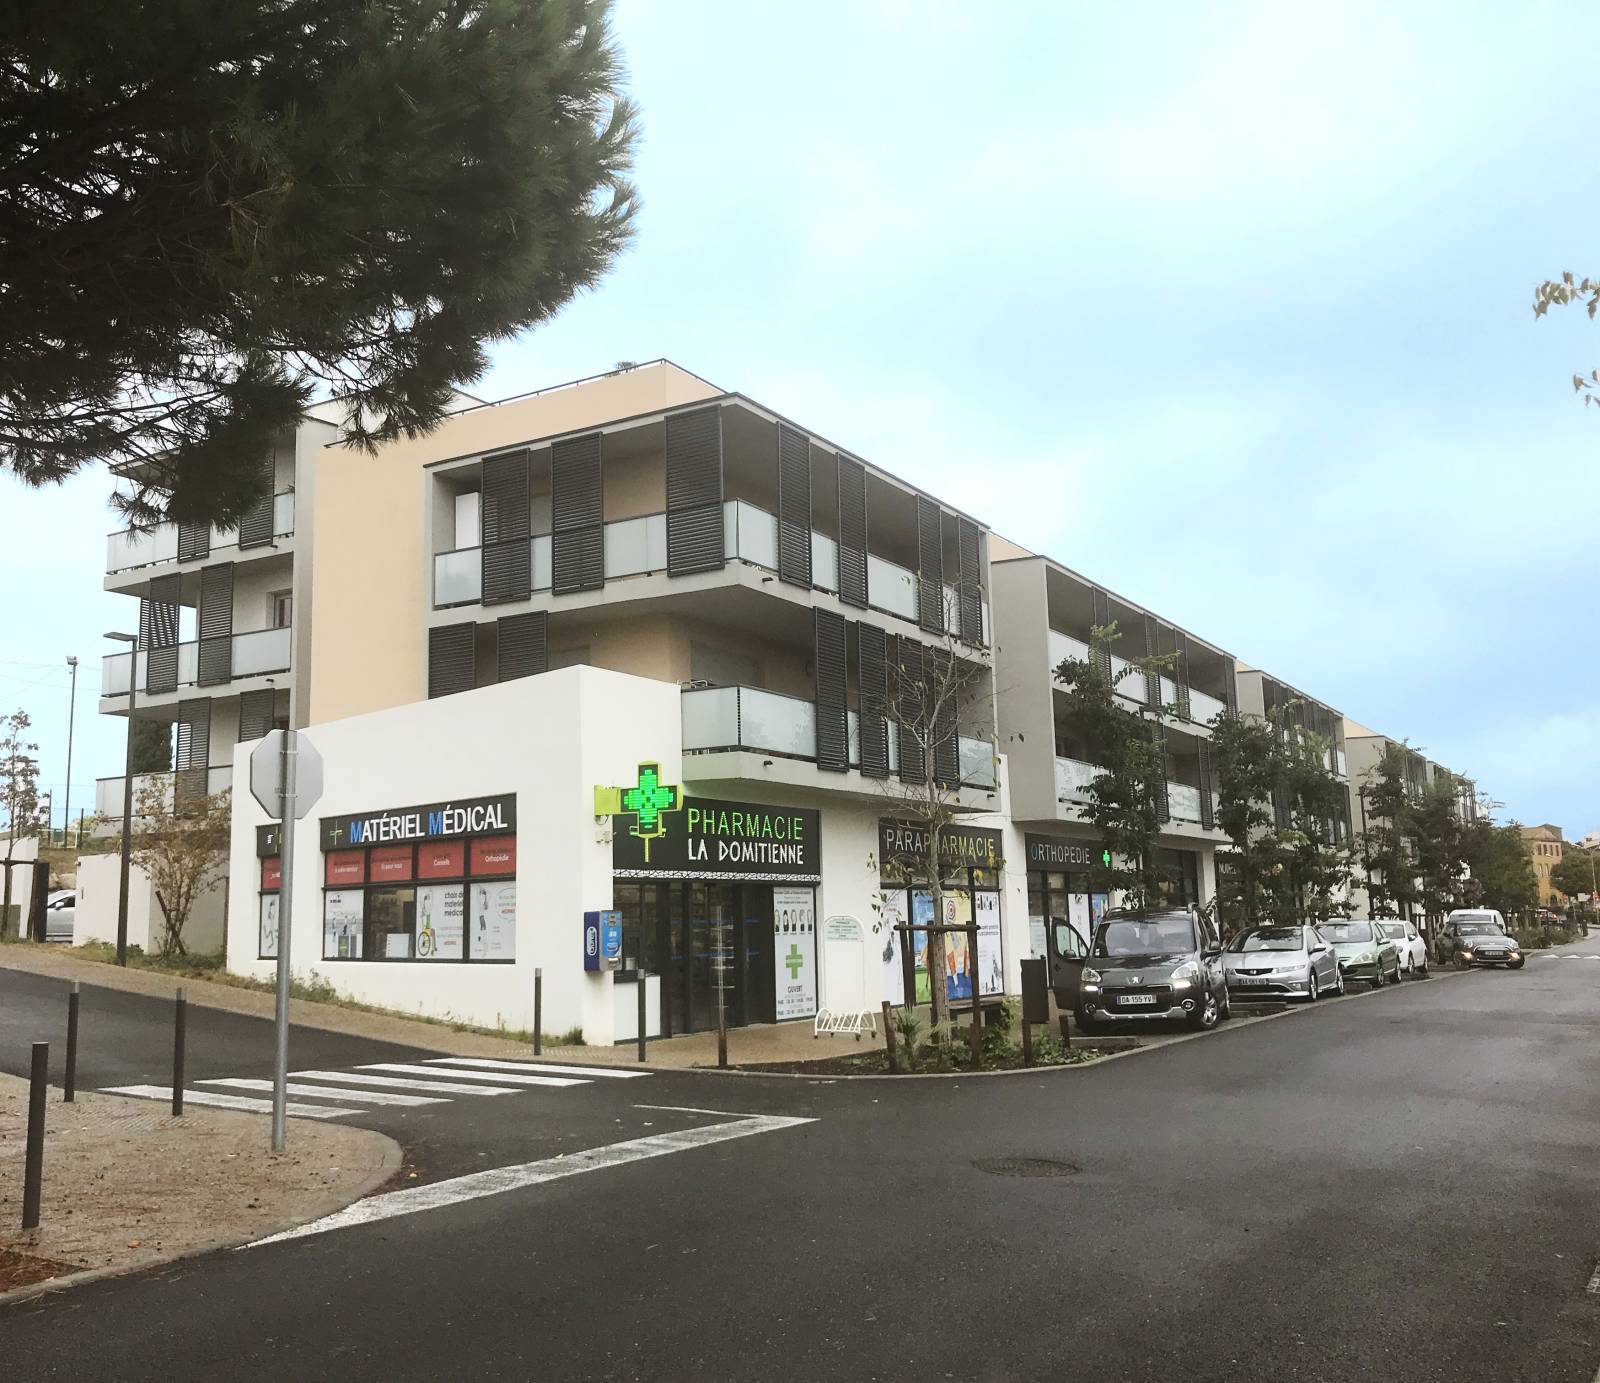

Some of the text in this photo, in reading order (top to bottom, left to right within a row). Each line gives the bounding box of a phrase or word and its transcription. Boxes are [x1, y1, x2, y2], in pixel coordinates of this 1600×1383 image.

[350, 804, 508, 844] MATÉRIEL MÉDICAL
[687, 807, 803, 841] PHARMACIE
[687, 838, 804, 865] LA DOMITIENNE
[886, 829, 995, 856] PARAPARMACIE
[1031, 842, 1091, 865] ORTHOPEDIE
